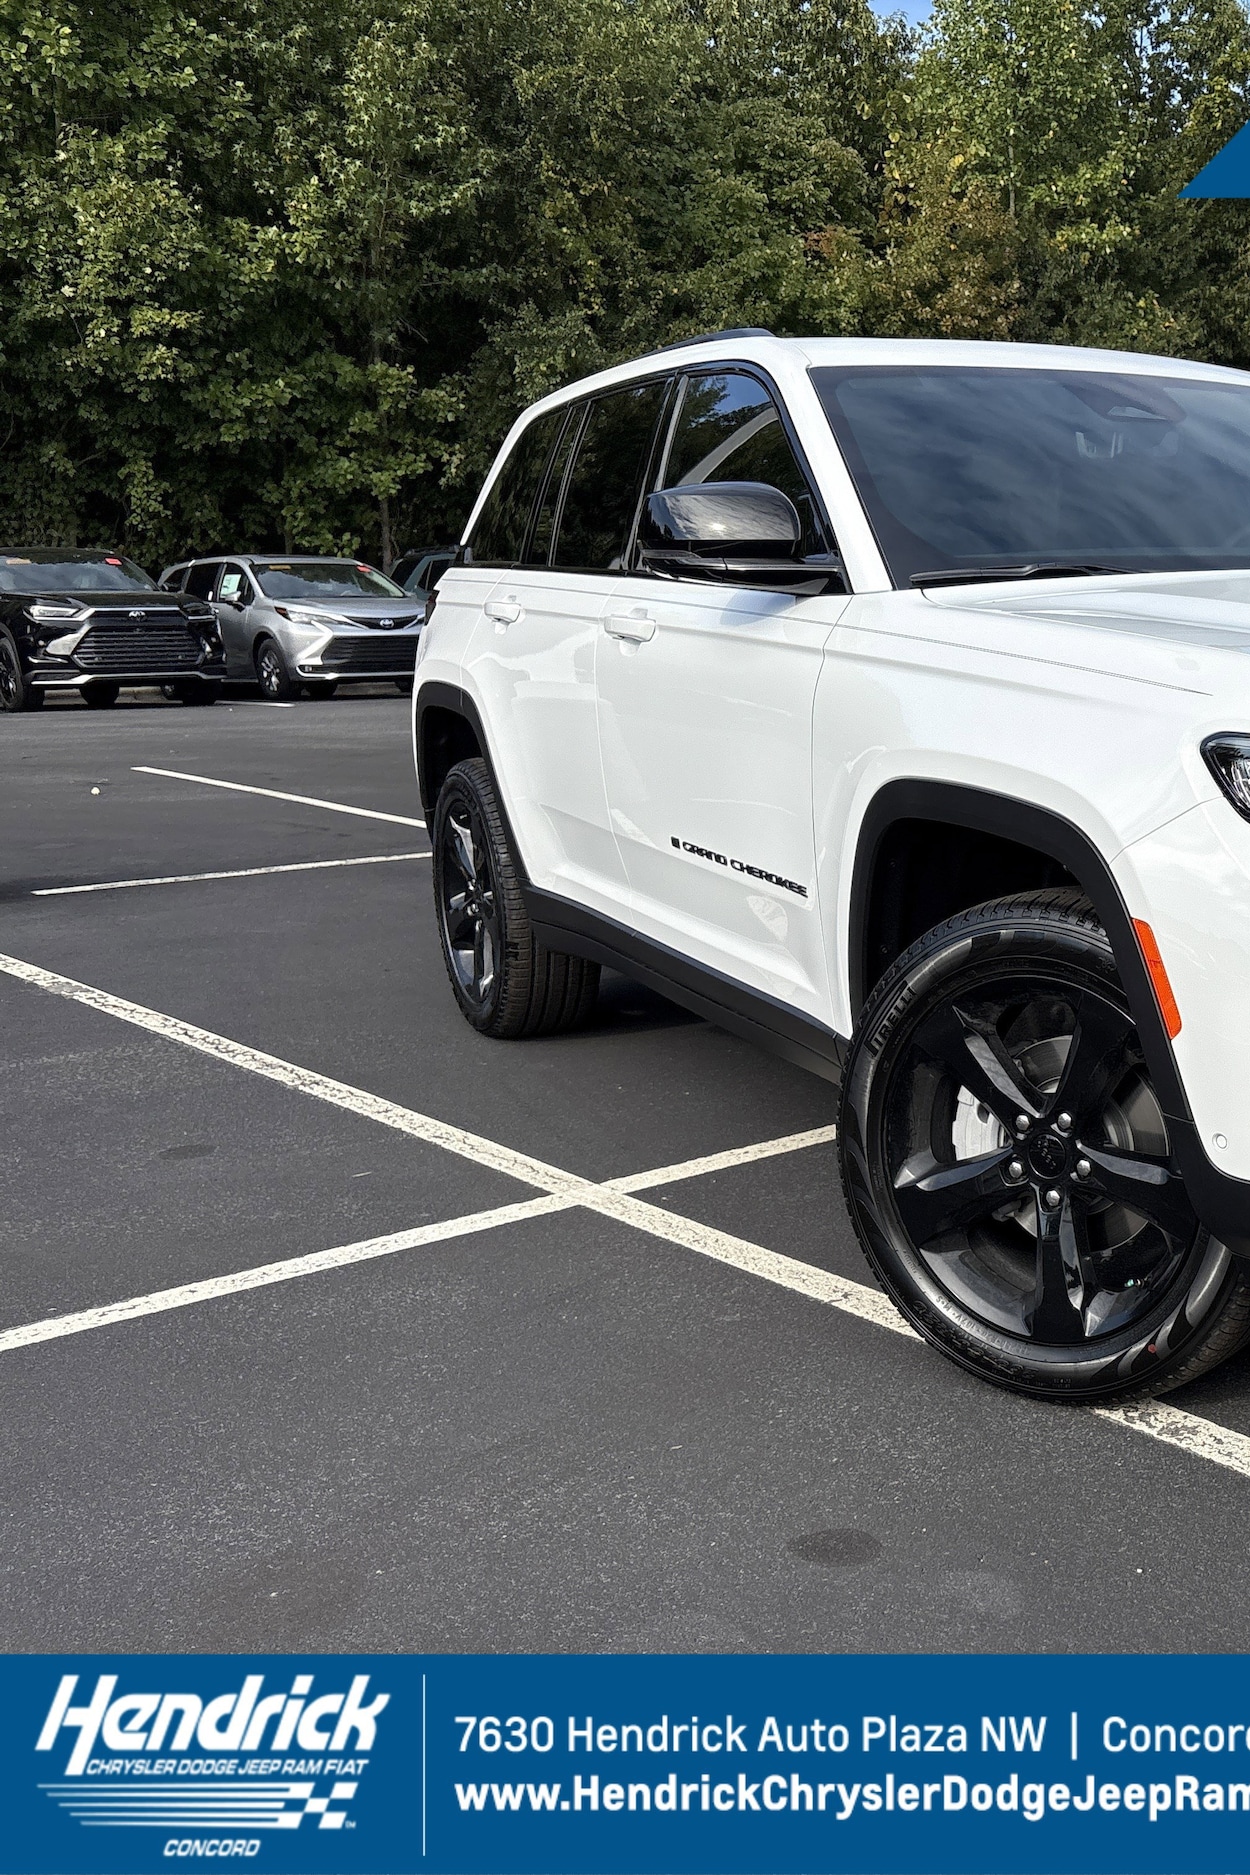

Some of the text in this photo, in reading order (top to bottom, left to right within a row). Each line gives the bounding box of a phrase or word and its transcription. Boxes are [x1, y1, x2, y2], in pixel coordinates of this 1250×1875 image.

[682, 841, 808, 898] GRAND CHEROKEE
[863, 980, 918, 1057] PIRELLI
